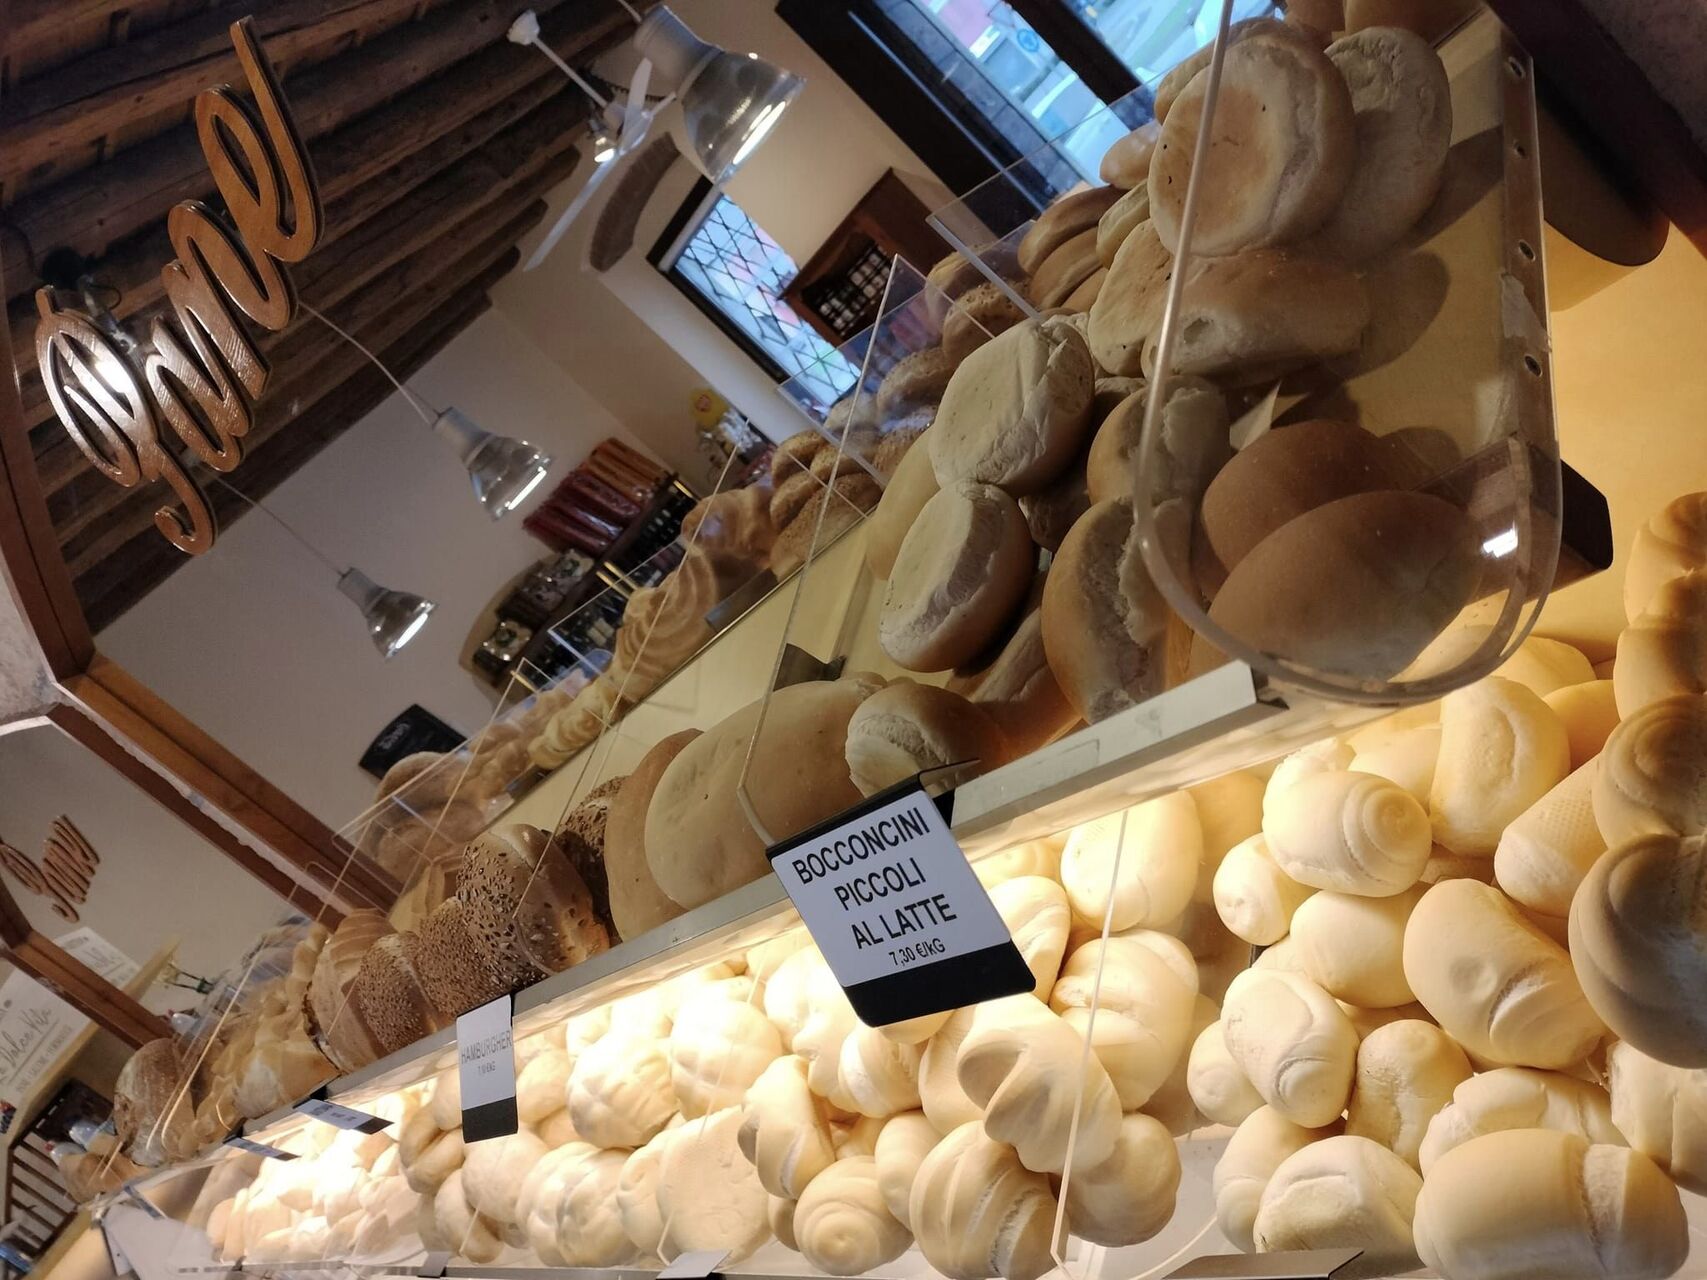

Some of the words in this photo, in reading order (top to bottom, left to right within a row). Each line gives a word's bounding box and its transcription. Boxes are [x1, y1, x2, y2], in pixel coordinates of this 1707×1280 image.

[36, 16, 322, 555] Pane
[793, 808, 930, 884] BOCCONCINI
[834, 858, 926, 911] PICCOLI
[851, 921, 884, 949] AL
[881, 894, 957, 939] LATTE
[889, 947, 916, 967] 7,30
[462, 1031, 512, 1062] HAMBURGHER
